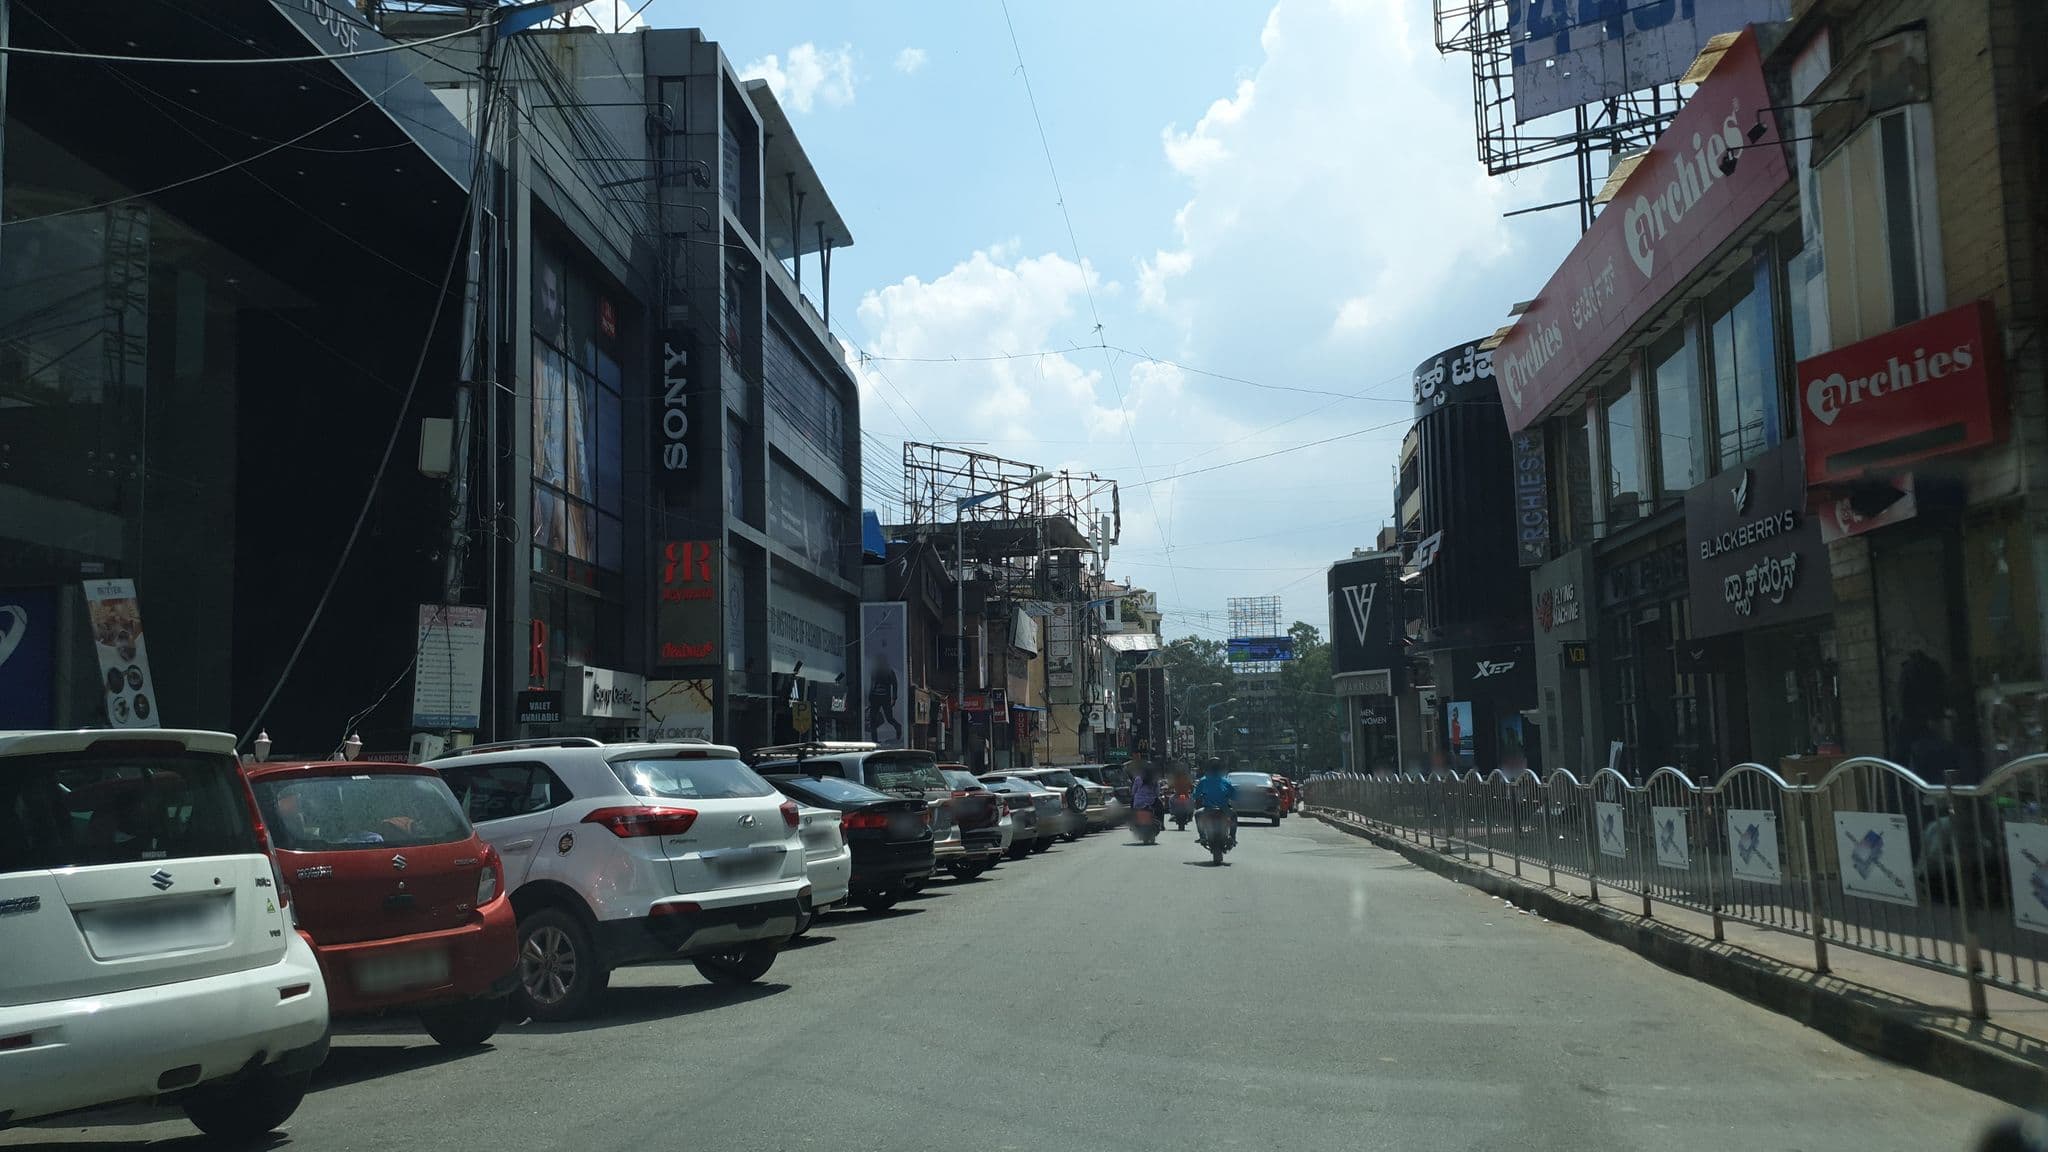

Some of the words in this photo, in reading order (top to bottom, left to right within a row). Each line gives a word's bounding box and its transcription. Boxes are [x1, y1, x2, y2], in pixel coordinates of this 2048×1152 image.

[663, 342, 688, 470] SONY
[1700, 509, 1794, 560] BLACKBERRYS
[1554, 583, 1574, 606] FLYING
[1343, 680, 1359, 691] VA
[529, 701, 551, 711] VALET
[520, 712, 560, 723] AVAILABLE
[1360, 707, 1375, 717] MEN
[1360, 715, 1387, 725] WOMEN
